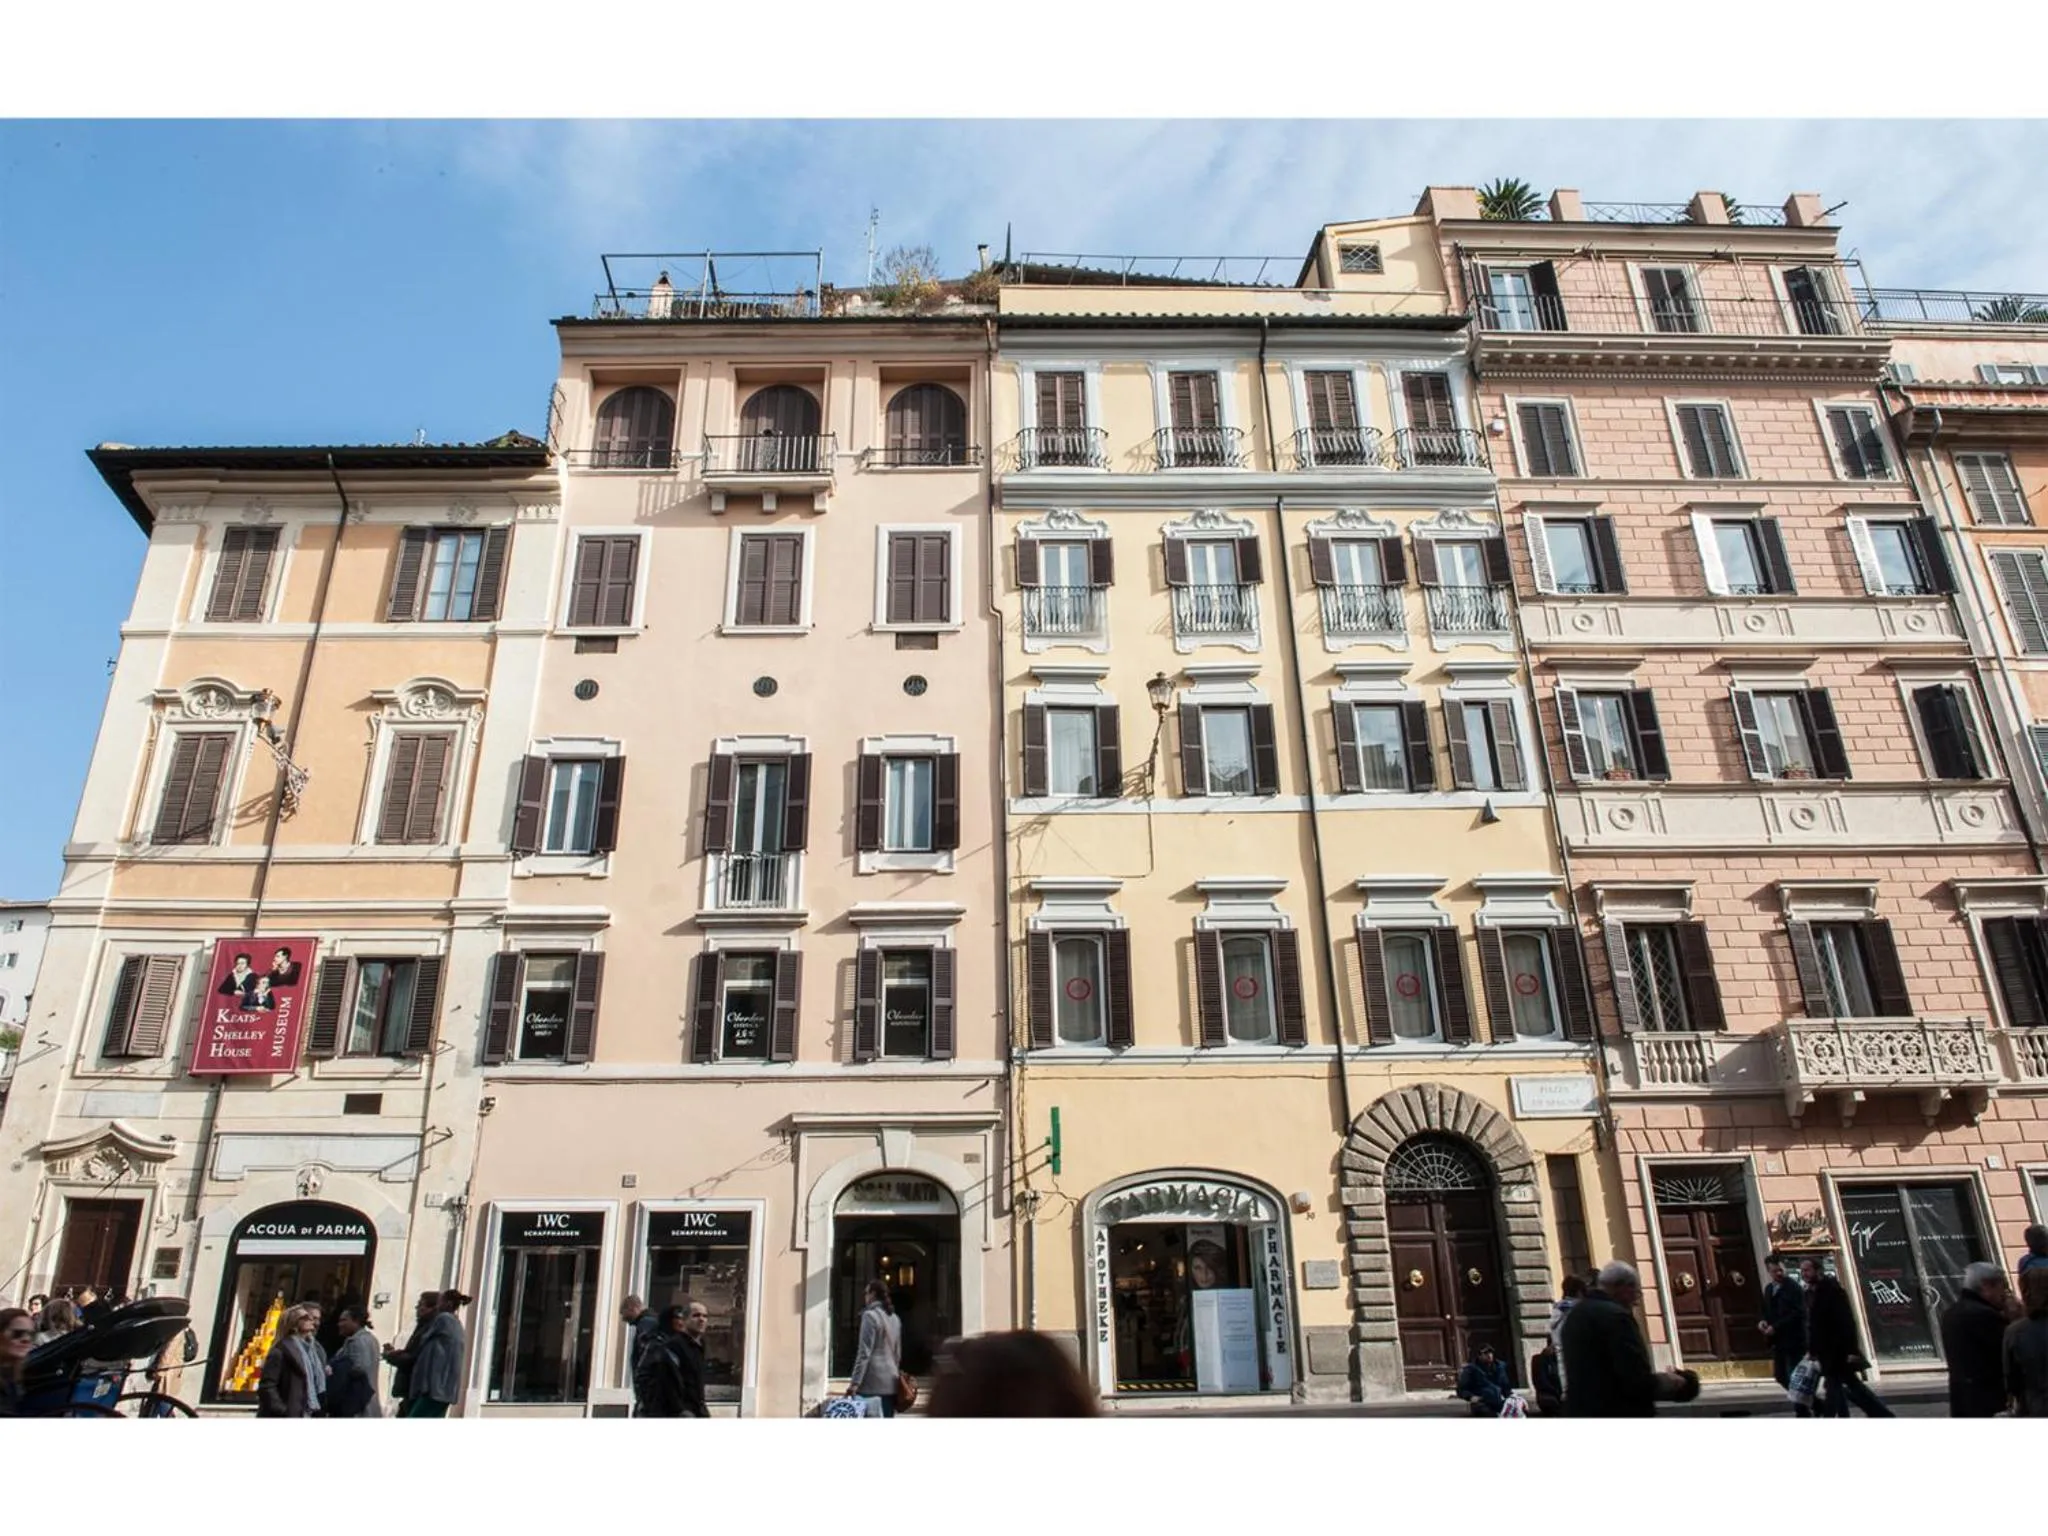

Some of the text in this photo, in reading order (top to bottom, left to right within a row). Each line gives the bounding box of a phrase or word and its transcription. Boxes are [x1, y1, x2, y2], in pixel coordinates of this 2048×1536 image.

[212, 1025, 266, 1040] SHELLEY
[271, 996, 293, 1057] MUSEUM
[208, 1042, 253, 1058] HOUSE
[1104, 1184, 1262, 1219] FARMACIA
[536, 1213, 571, 1229] IWC
[683, 1213, 718, 1228] IWC
[246, 1223, 297, 1235] ACQUA
[315, 1224, 367, 1236] PARMA
[1096, 1230, 1109, 1343] APOTHEKE
[1266, 1227, 1287, 1355] PHARMACIE
